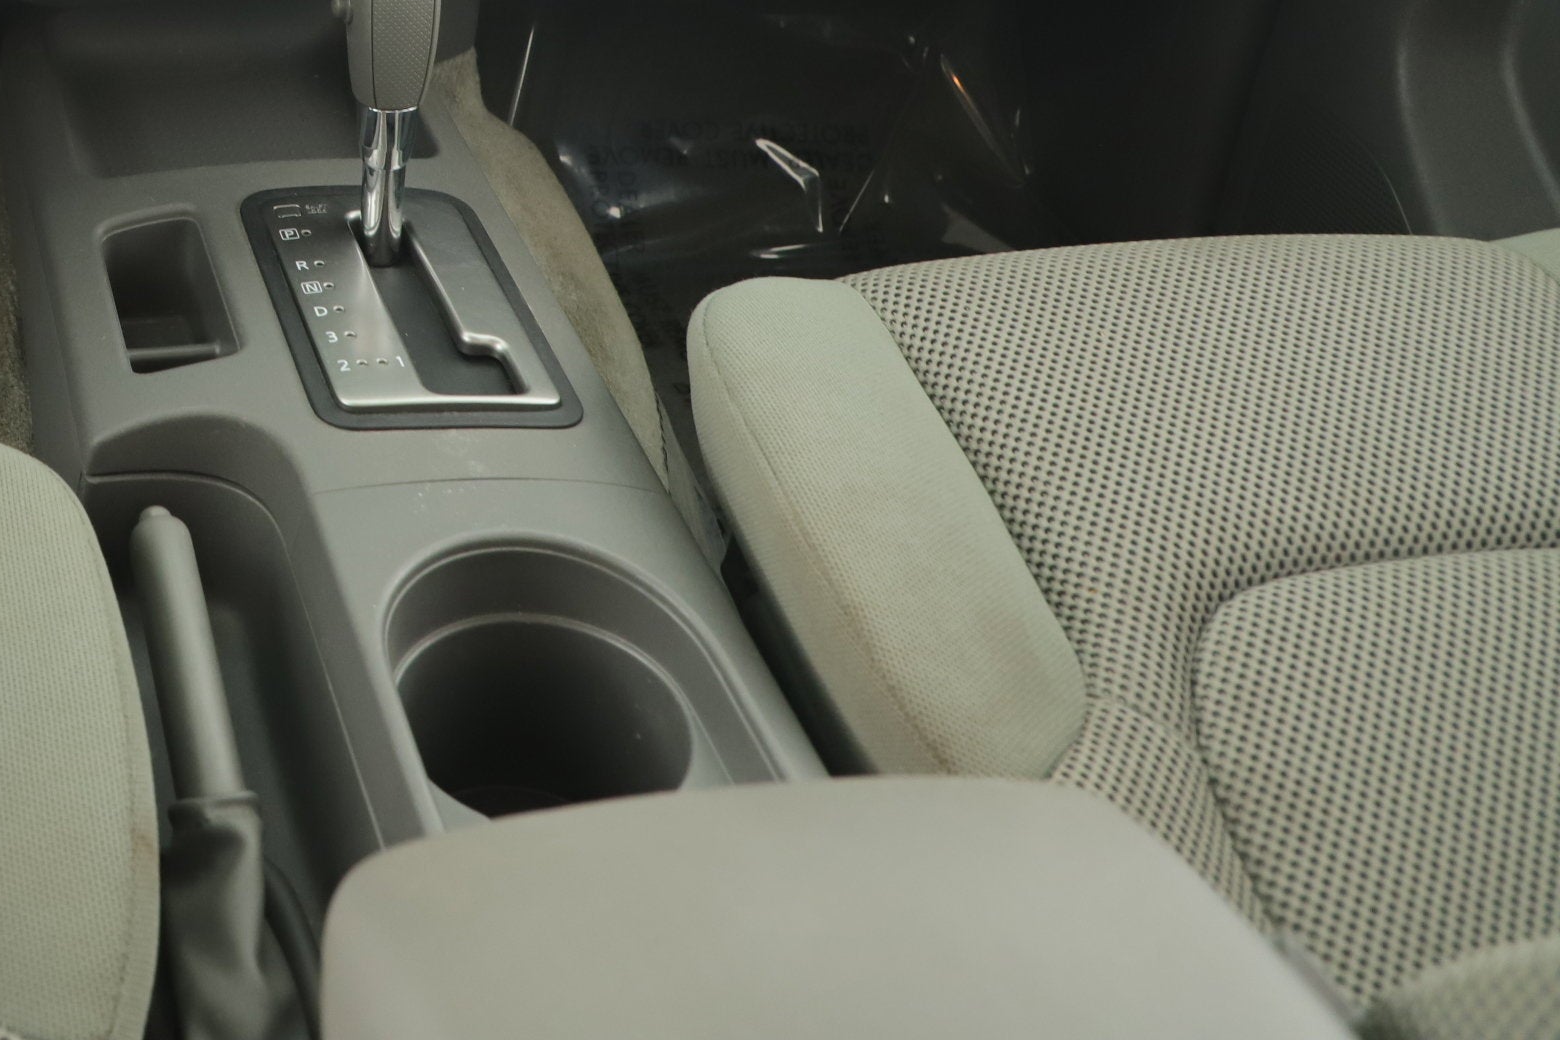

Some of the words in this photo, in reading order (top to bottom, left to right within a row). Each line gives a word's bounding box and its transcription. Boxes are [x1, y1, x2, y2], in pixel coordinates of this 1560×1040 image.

[295, 260, 309, 271] R
[313, 306, 328, 318] D
[325, 331, 338, 343] 3
[337, 359, 351, 372] 2
[396, 356, 405, 367] 1
